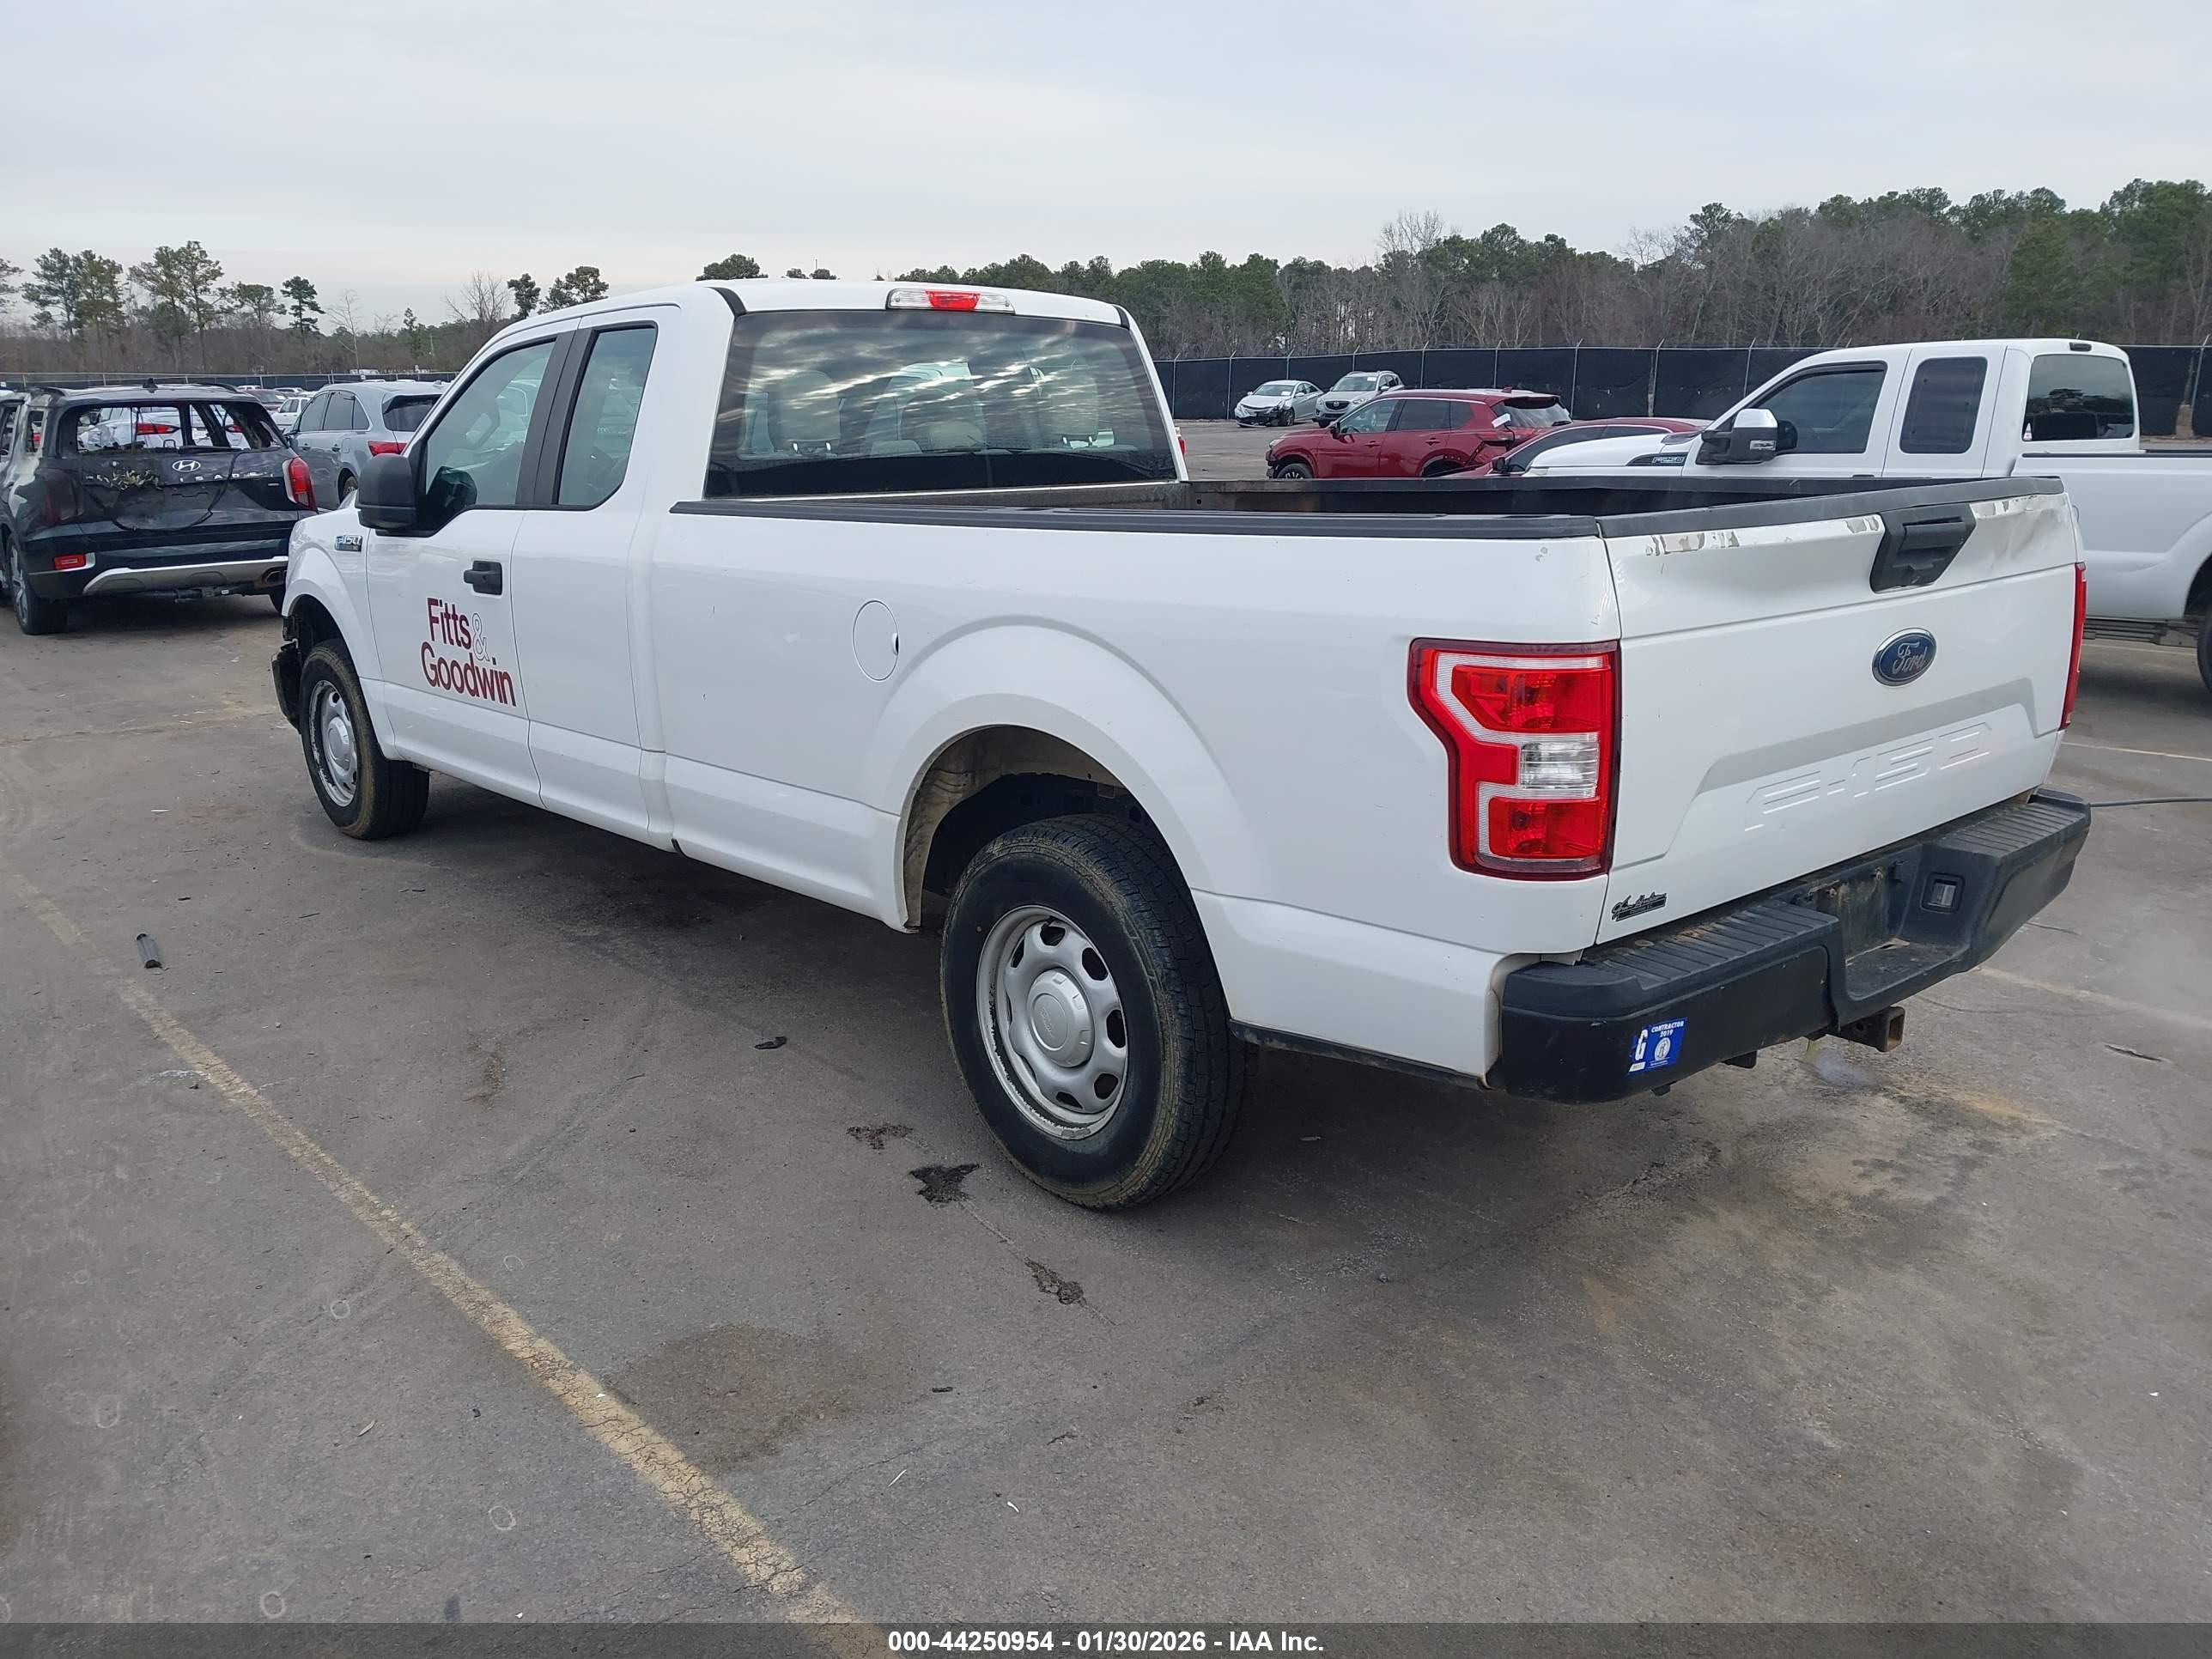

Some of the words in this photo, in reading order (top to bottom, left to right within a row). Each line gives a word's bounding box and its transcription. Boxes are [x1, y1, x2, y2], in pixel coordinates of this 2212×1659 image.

[427, 597, 472, 650] Fitts
[471, 612, 490, 661] &
[420, 641, 517, 707] Goodwin
[1892, 641, 1929, 675] Ford
[1651, 1021, 1684, 1032] CONTRACTOR
